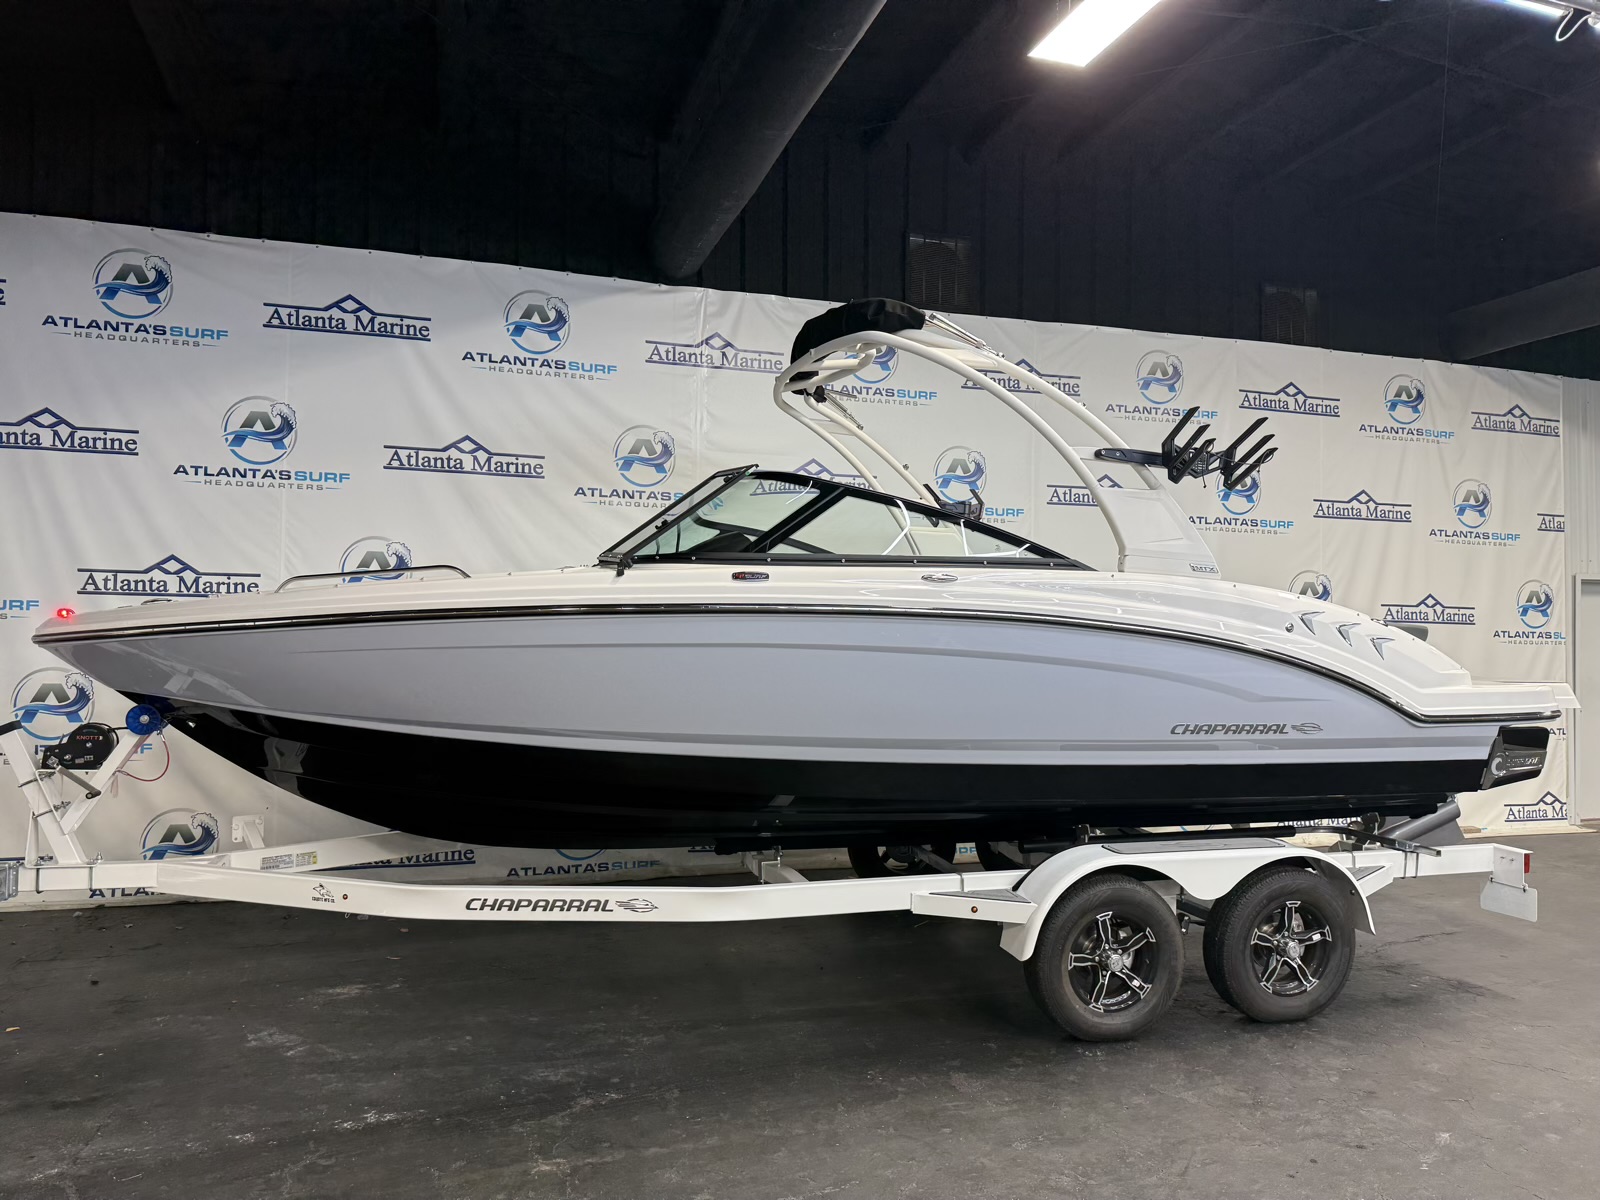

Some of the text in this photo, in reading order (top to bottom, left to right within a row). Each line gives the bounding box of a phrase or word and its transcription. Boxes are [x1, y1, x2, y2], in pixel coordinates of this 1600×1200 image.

[265, 307, 431, 338] Atlanta Marine
[73, 331, 201, 347] HEADQUARTERS
[647, 345, 784, 371] Atlanta Marine
[488, 365, 595, 381] HEADQUARTERS
[1241, 393, 1340, 415] Atlanta Marine
[1473, 415, 1560, 435] Atlanta Marine
[50, 429, 138, 451] Marine
[1374, 434, 1441, 444] HEADQUARTERS
[386, 449, 544, 477] Atlanta Marine
[203, 479, 324, 491] HEADQUARTERS
[599, 499, 667, 508] HEADQUAR
[1314, 502, 1412, 520] Atlanta Marine
[985, 507, 1025, 517] SURF
[1205, 526, 1278, 535] HEADQUARTERS
[1444, 538, 1507, 547] HEADQUARTERS
[80, 572, 260, 594] Atlanta Marine
[1383, 607, 1475, 623] Atlanta Marine
[1170, 722, 1289, 736] CHAPARRAL
[1506, 806, 1548, 819] Atlanta
[465, 897, 614, 913] CHAPARRAL
